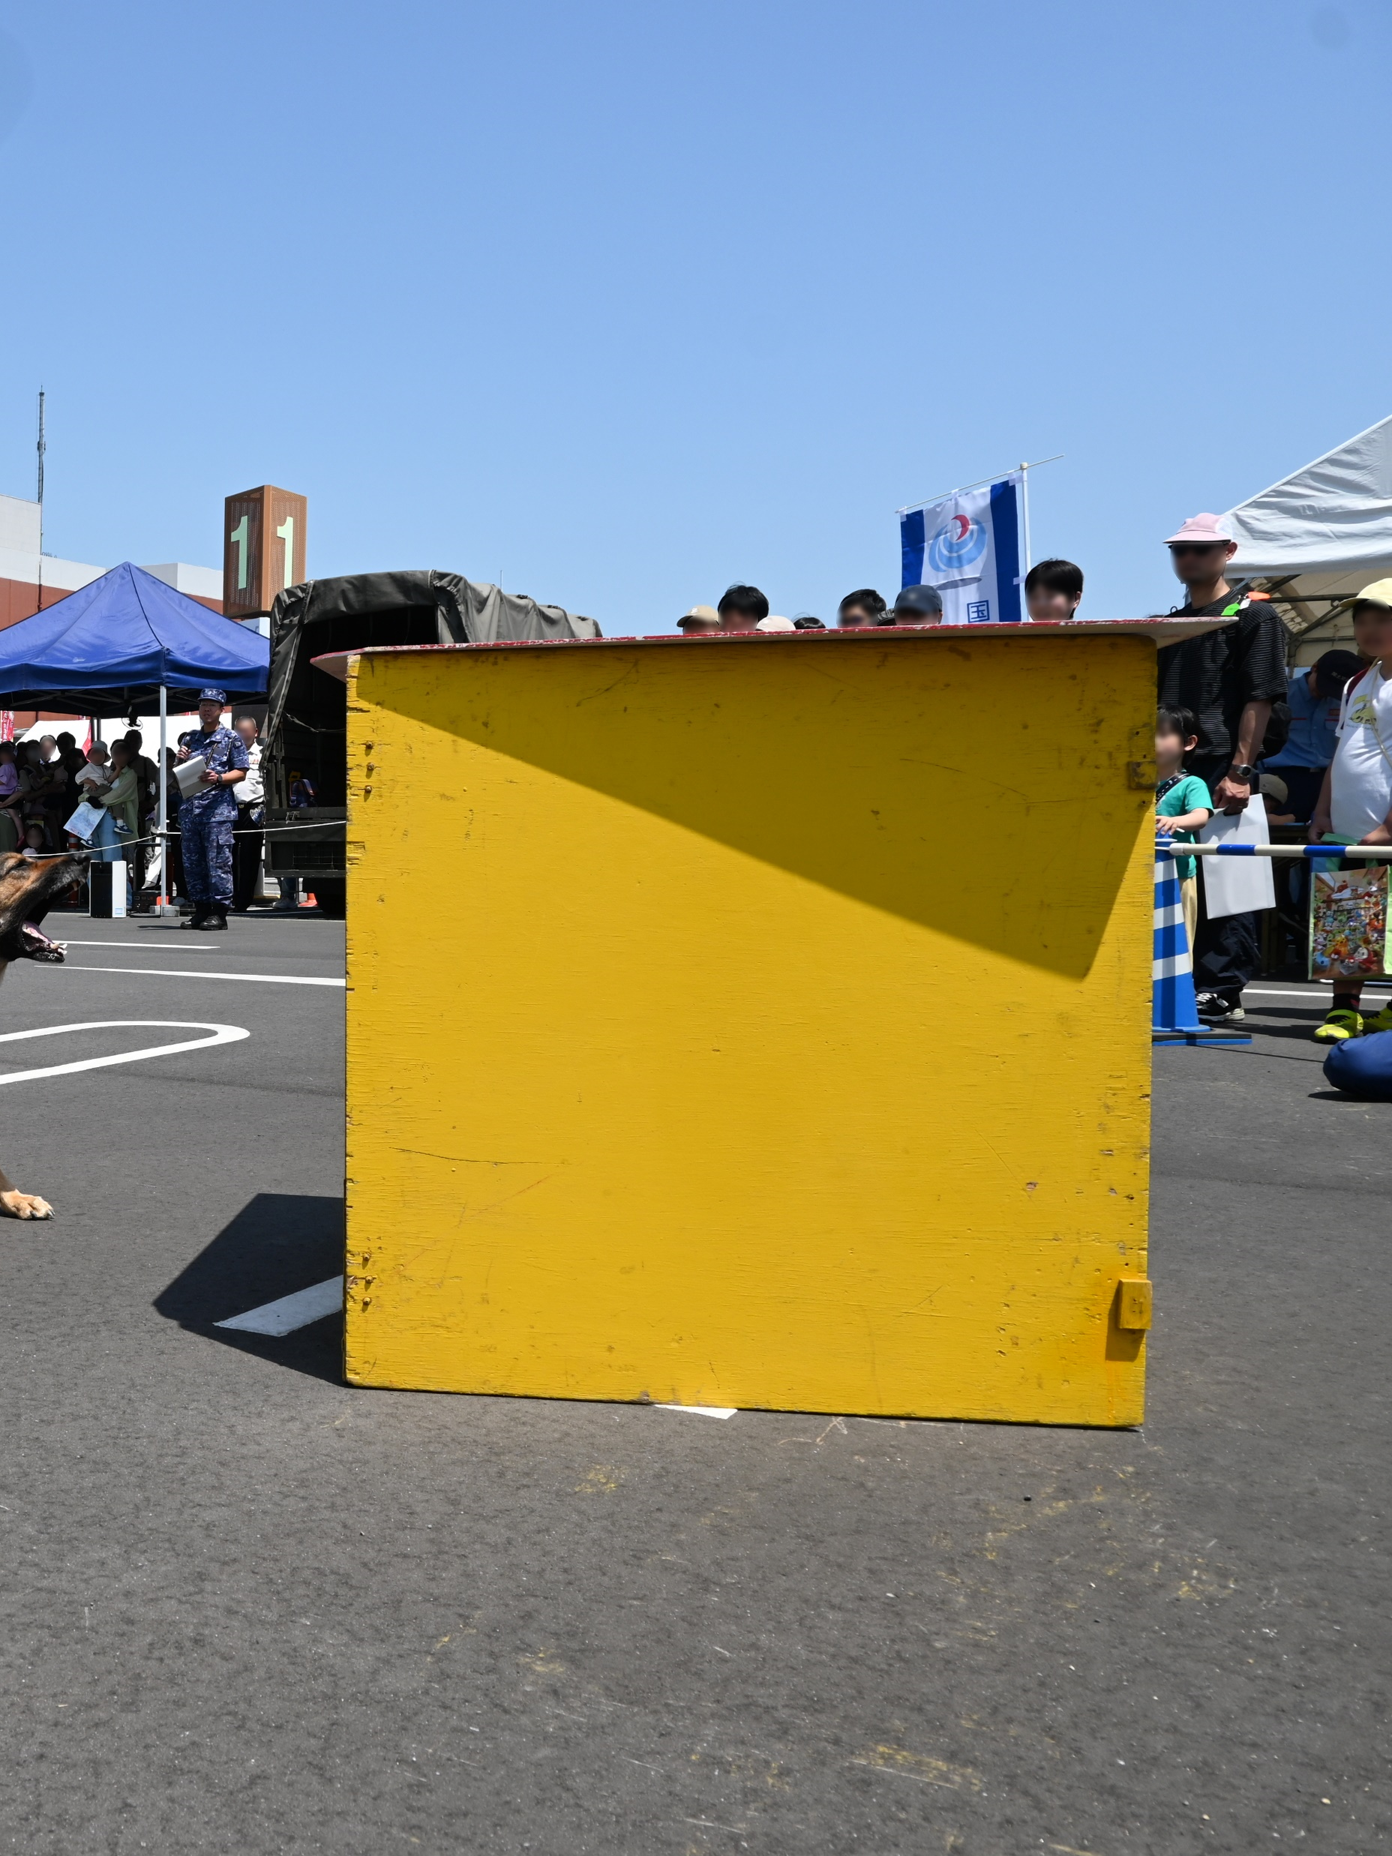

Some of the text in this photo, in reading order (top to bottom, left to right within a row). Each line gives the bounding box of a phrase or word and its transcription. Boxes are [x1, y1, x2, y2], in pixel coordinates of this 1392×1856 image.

[230, 515, 248, 590] 1
[276, 515, 294, 589] 1
[967, 599, 990, 623] 国
